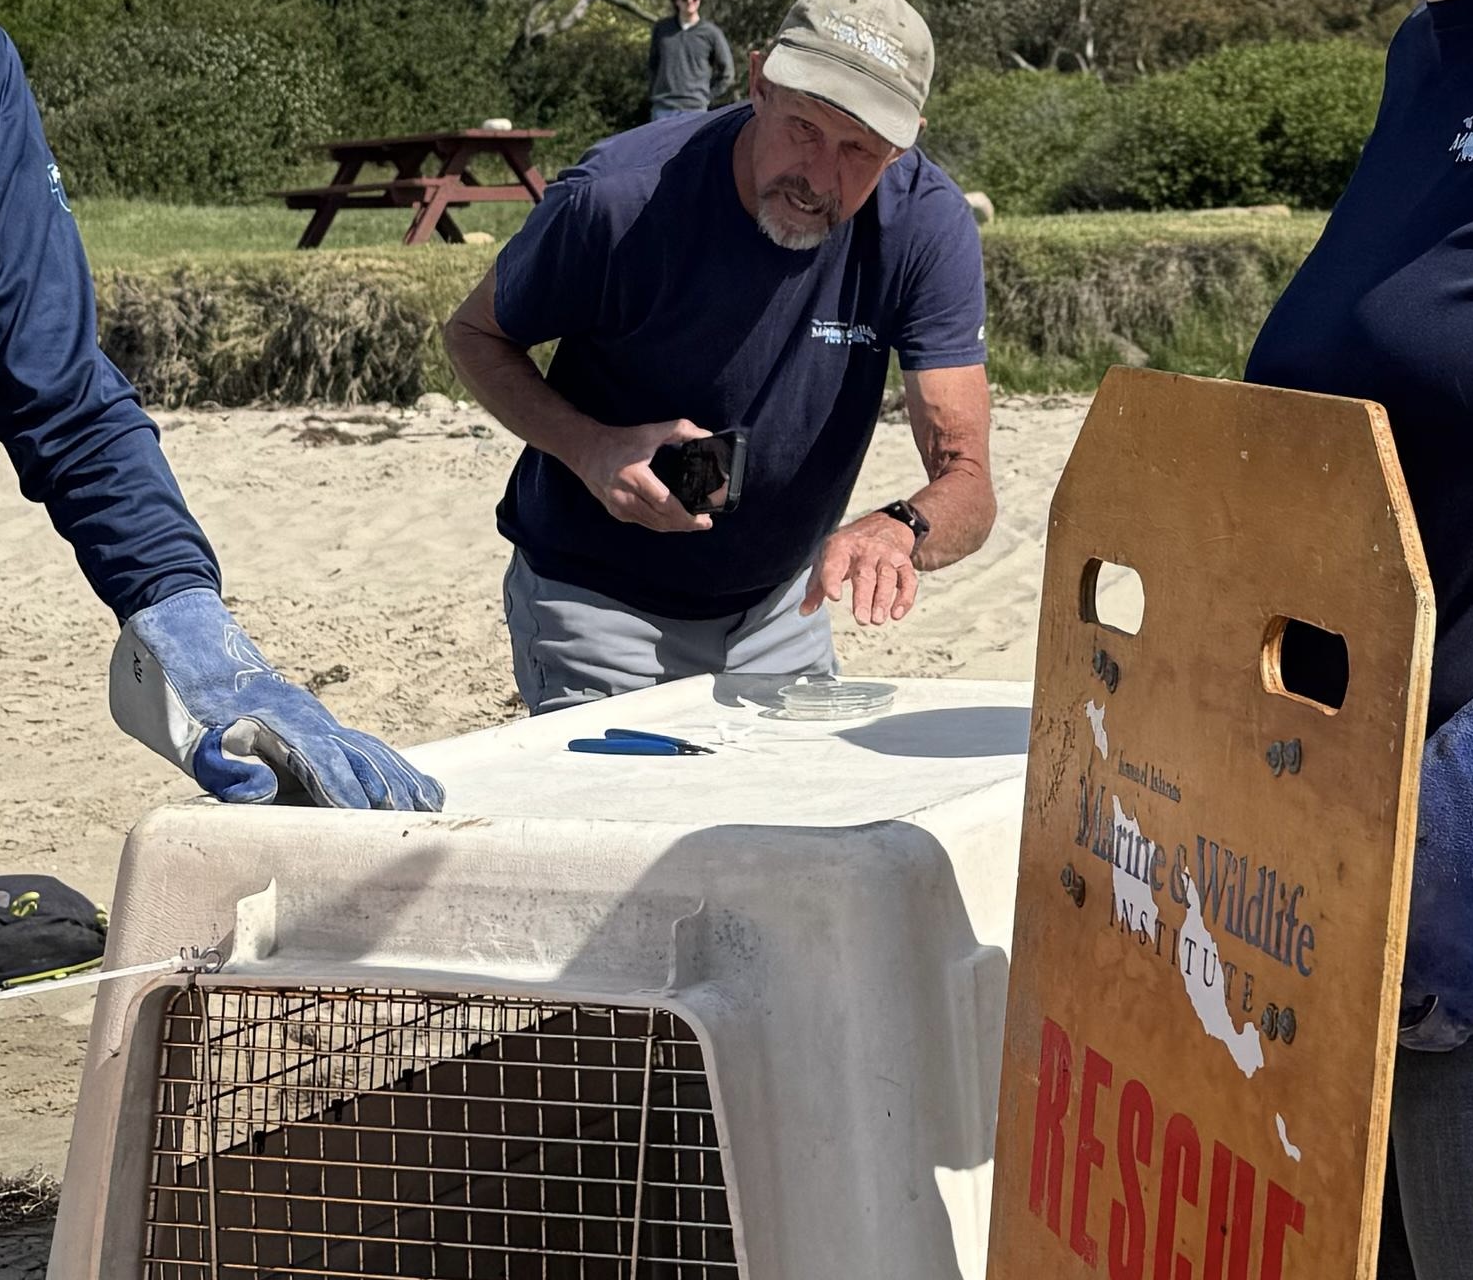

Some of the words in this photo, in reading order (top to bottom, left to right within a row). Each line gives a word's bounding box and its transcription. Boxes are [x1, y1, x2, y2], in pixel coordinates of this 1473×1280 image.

[1075, 773, 1167, 892] Marine
[1196, 834, 1315, 977] Wildlife
[1109, 892, 1255, 1014] INSTITUTE
